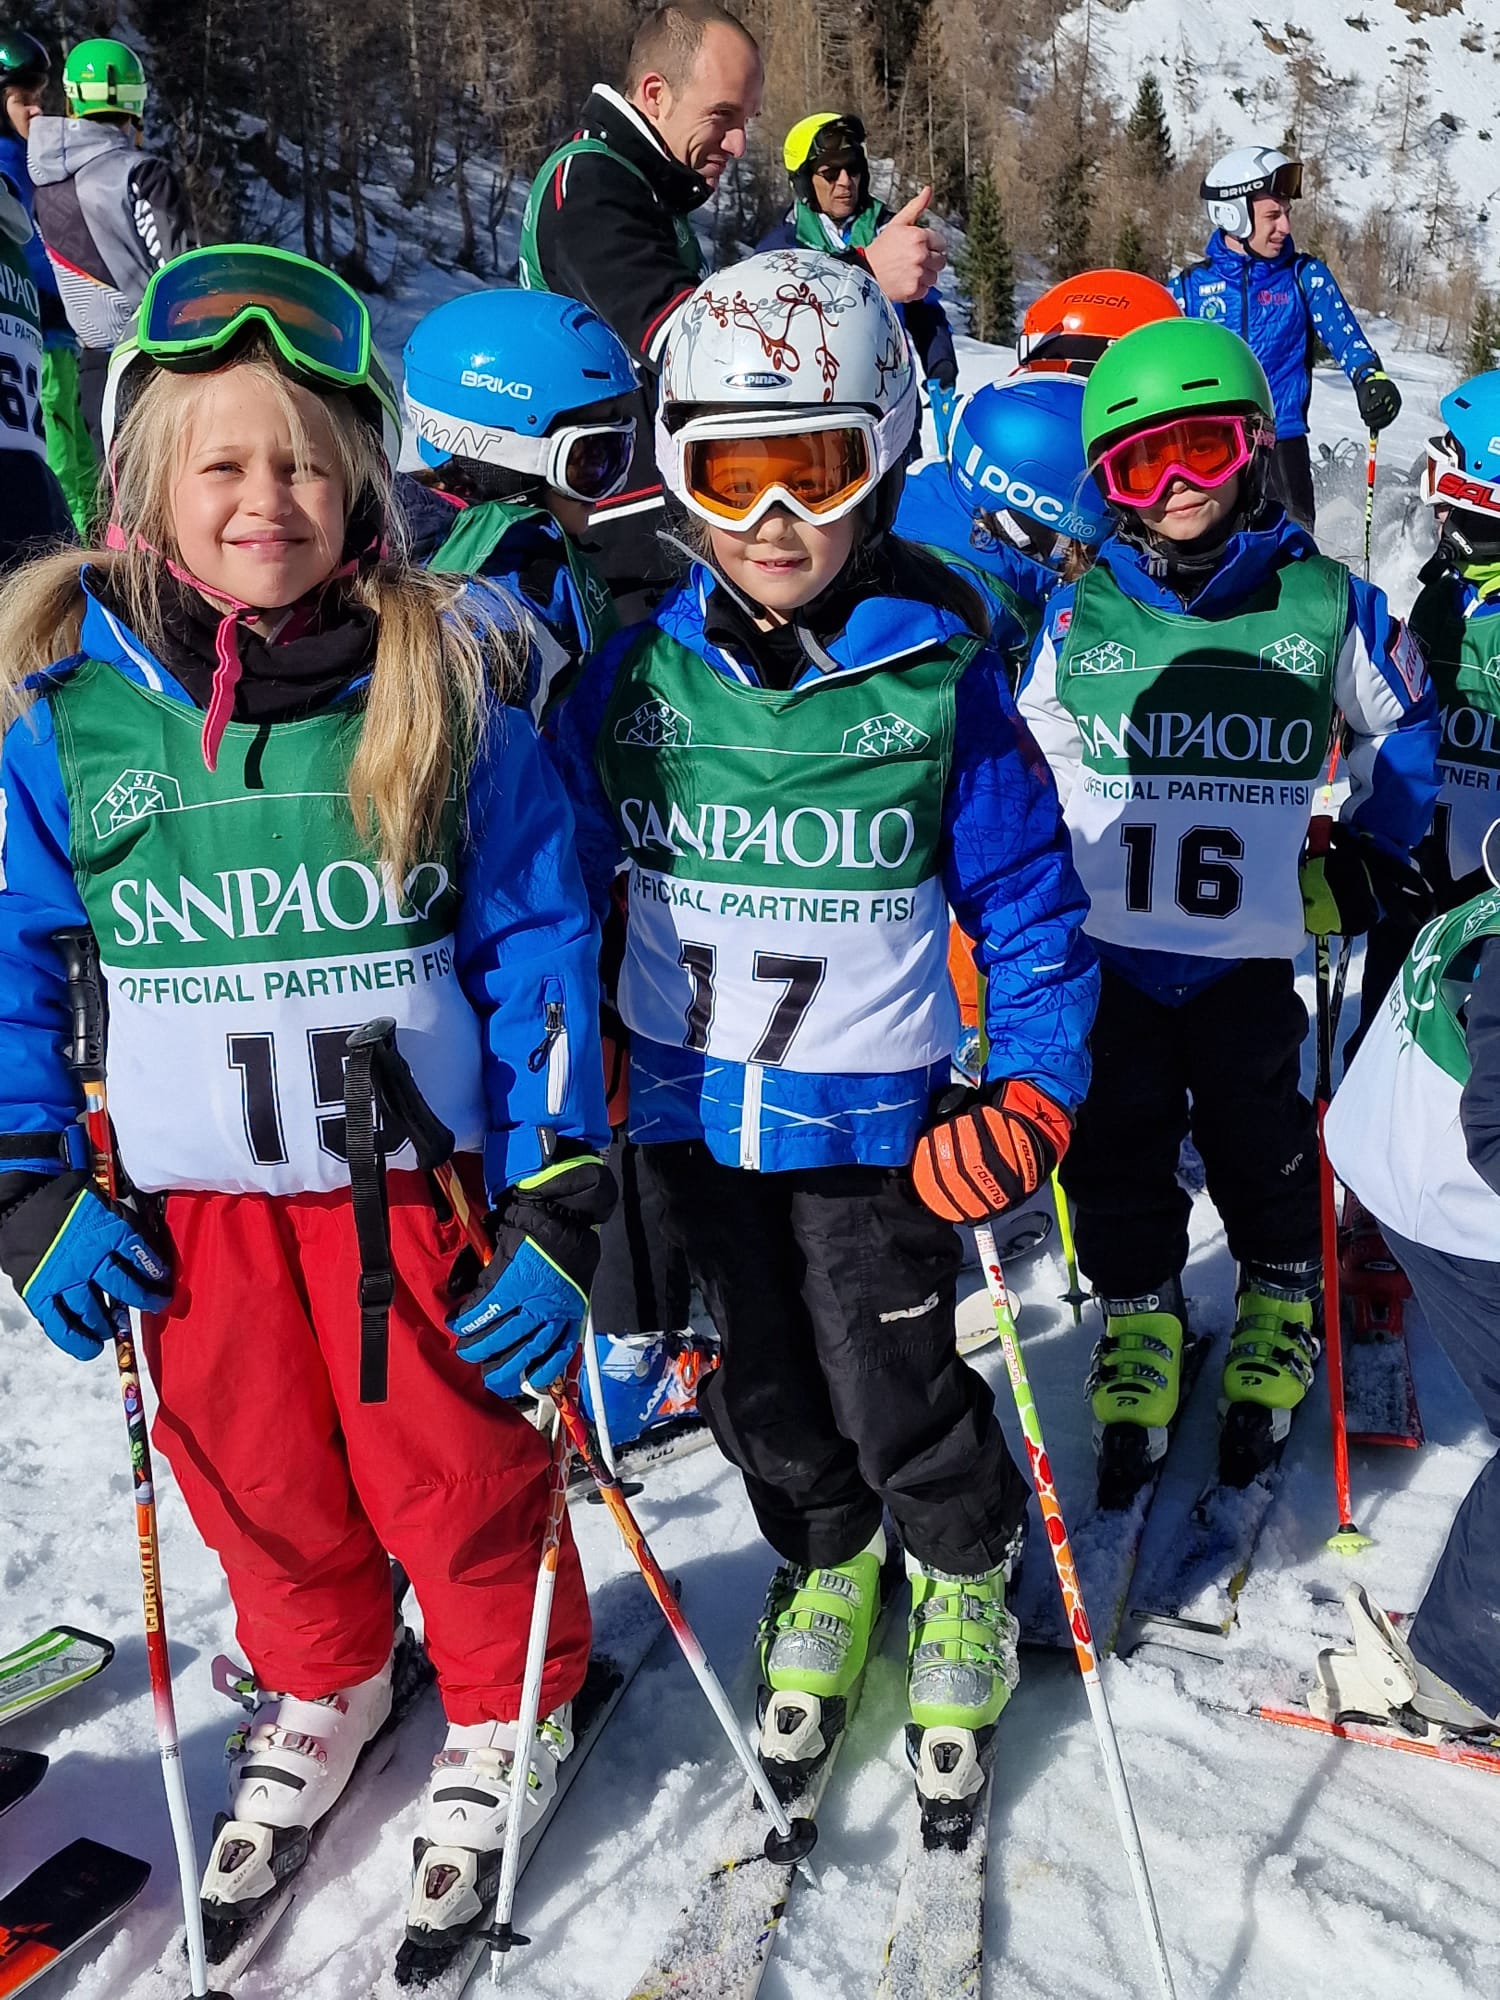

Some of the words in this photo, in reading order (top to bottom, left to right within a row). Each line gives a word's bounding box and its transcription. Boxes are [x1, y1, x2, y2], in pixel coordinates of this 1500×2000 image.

[1219, 180, 1265, 198] BRIKO
[1063, 293, 1131, 310] reusch
[460, 369, 533, 401] BRIKO
[1076, 711, 1313, 765] SANPAOLO
[1167, 780, 1275, 805] PARTNER
[1279, 785, 1309, 806] FISI
[620, 797, 915, 869] SANPAOLO
[1119, 822, 1245, 920] 16
[111, 859, 449, 947] SANPAOLO
[720, 892, 860, 923] PARTNER
[870, 895, 916, 924] FISI
[118, 974, 255, 1005] OFFICIAL
[263, 958, 417, 1001] PARTNER
[678, 938, 828, 1067] 17
[1020, 1138, 1038, 1188] reusch
[972, 1164, 1006, 1205] racing
[129, 1244, 165, 1281] reusch
[460, 1303, 502, 1335] reusch
